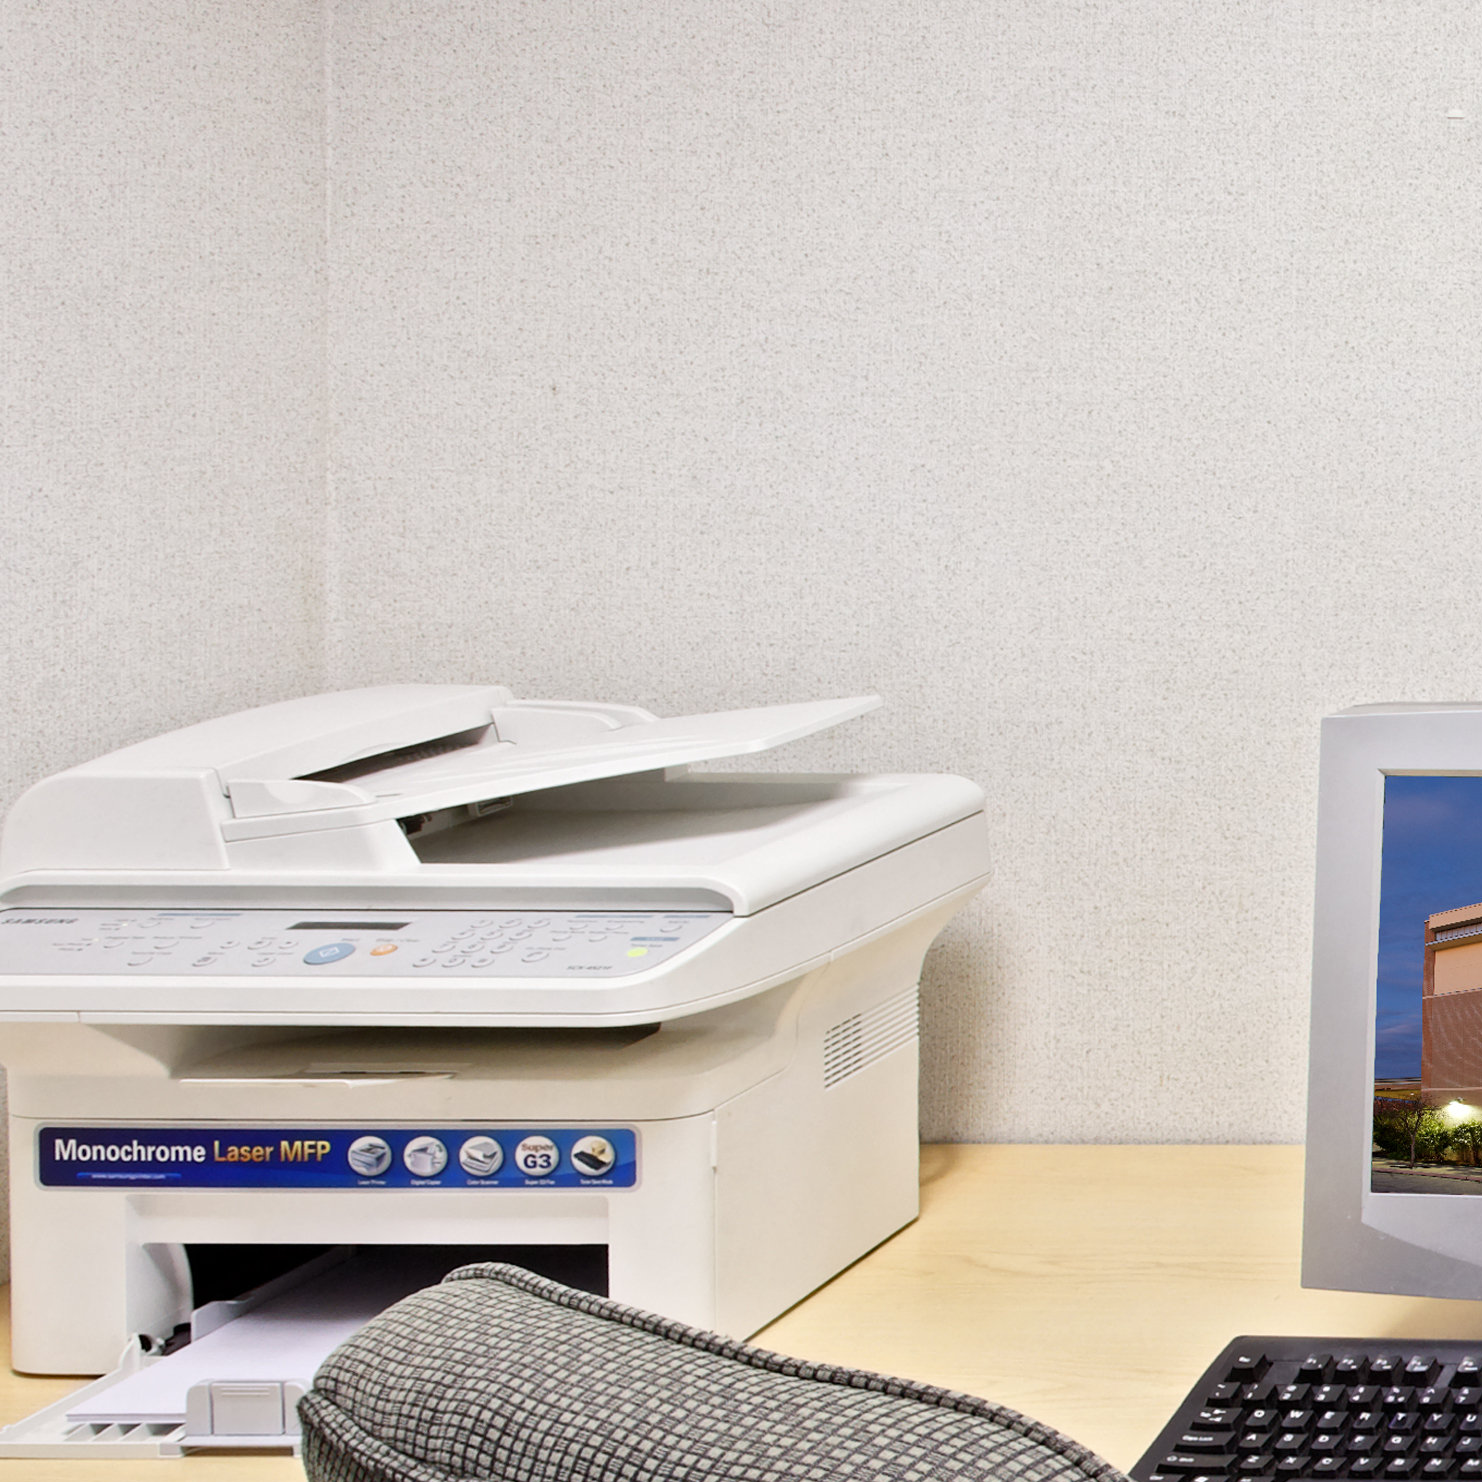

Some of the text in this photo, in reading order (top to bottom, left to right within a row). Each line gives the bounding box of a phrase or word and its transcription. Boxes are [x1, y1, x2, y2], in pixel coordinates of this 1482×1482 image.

[54, 1139, 331, 1162] Monochrome Laser MFP
[522, 1142, 554, 1153] Super
[524, 1154, 552, 1169] G3
